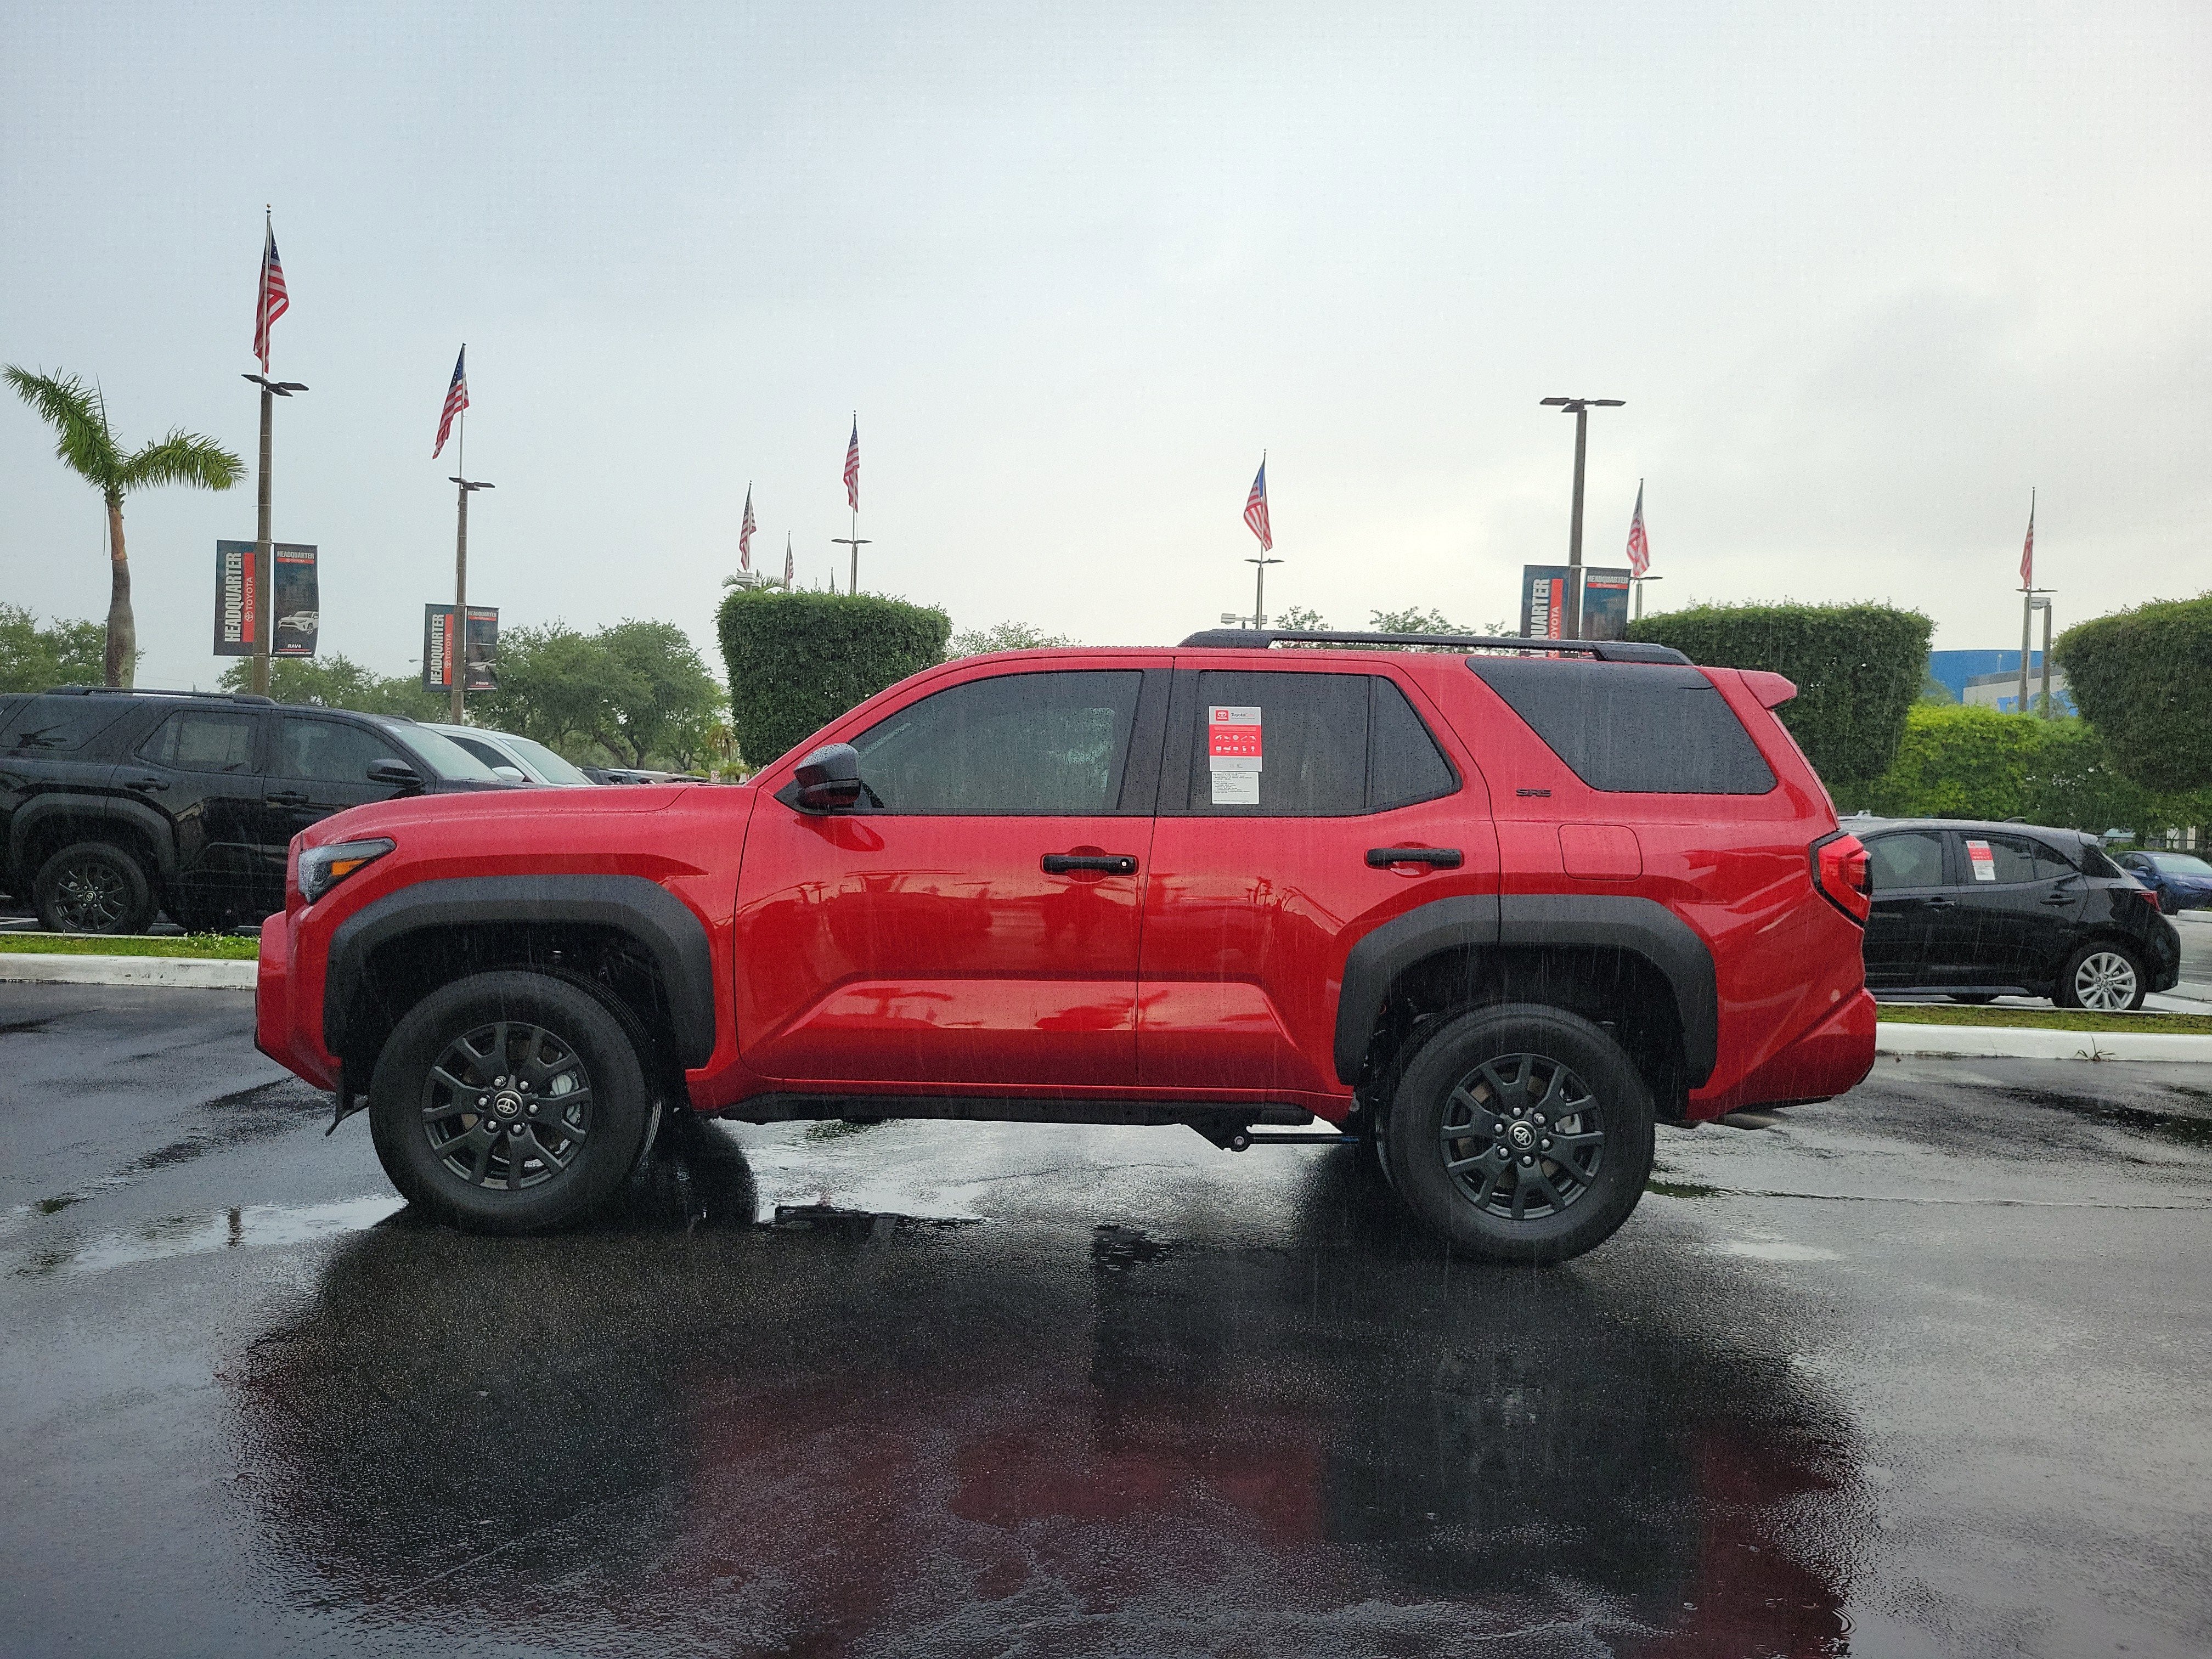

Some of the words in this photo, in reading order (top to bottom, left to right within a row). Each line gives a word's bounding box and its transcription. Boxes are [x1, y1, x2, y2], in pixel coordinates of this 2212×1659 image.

[276, 551, 314, 559] HEADQUARTER
[224, 552, 244, 642] HEADQUARTER
[1550, 606, 1560, 640] OYOTA
[430, 614, 444, 685] HEADQUARTER
